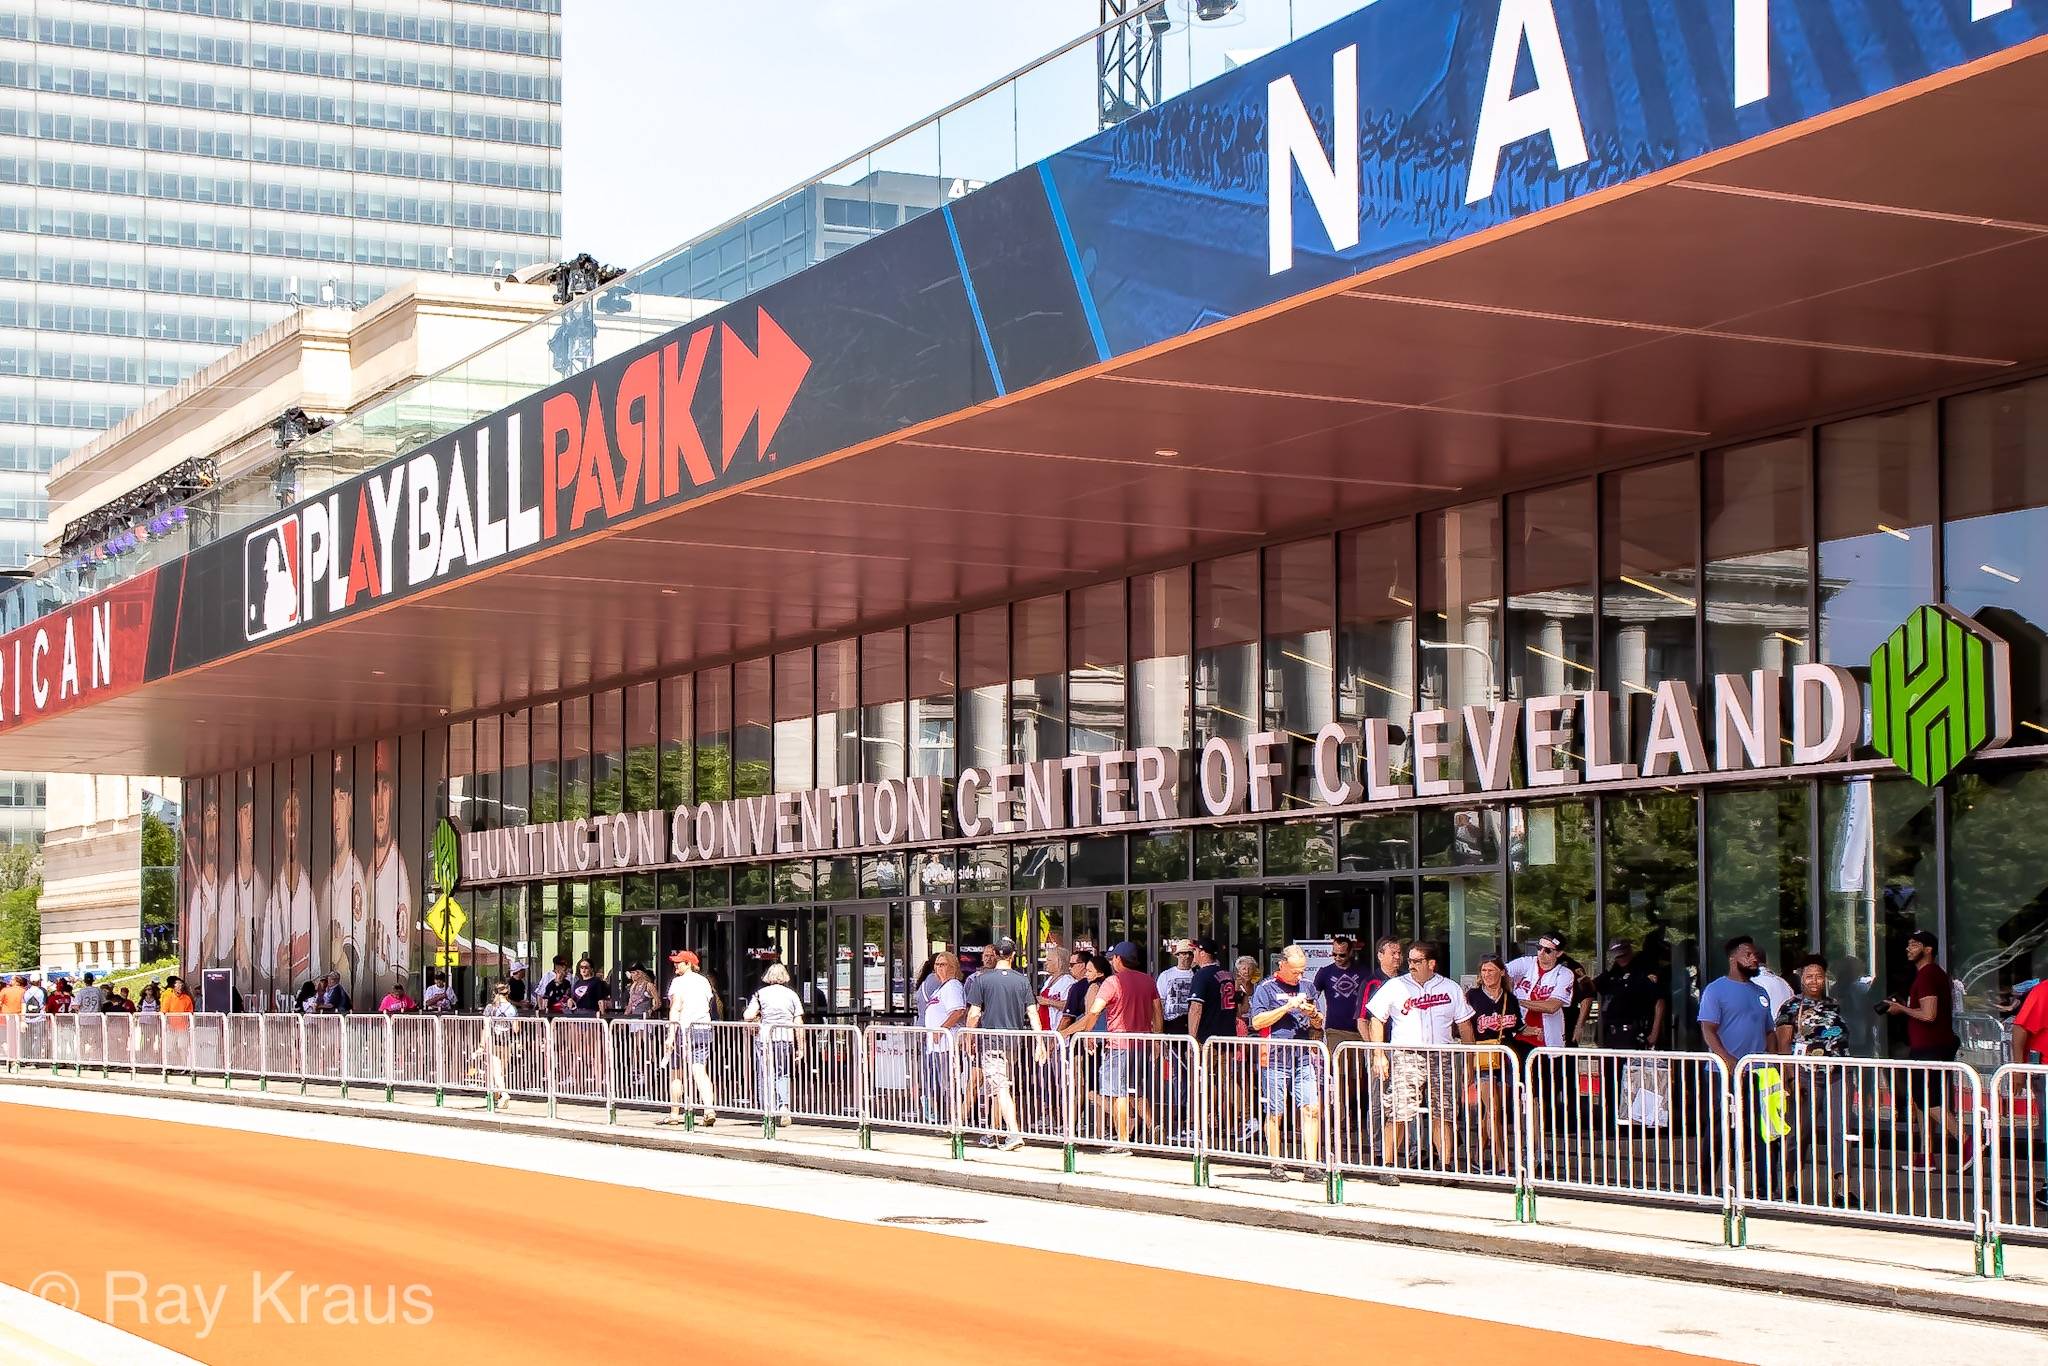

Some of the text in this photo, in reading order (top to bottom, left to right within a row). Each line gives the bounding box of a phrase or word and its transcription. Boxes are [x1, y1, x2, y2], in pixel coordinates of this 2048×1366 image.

[1267, 0, 2012, 276] NA
[0, 600, 112, 722] ICAN
[465, 662, 1860, 880] HUNTINGTON CONVENTION CENTER OF CLEVELAND
[976, 865, 991, 880] Ave
[84, 996, 98, 1008] 35
[1400, 991, 1452, 1016] Indians
